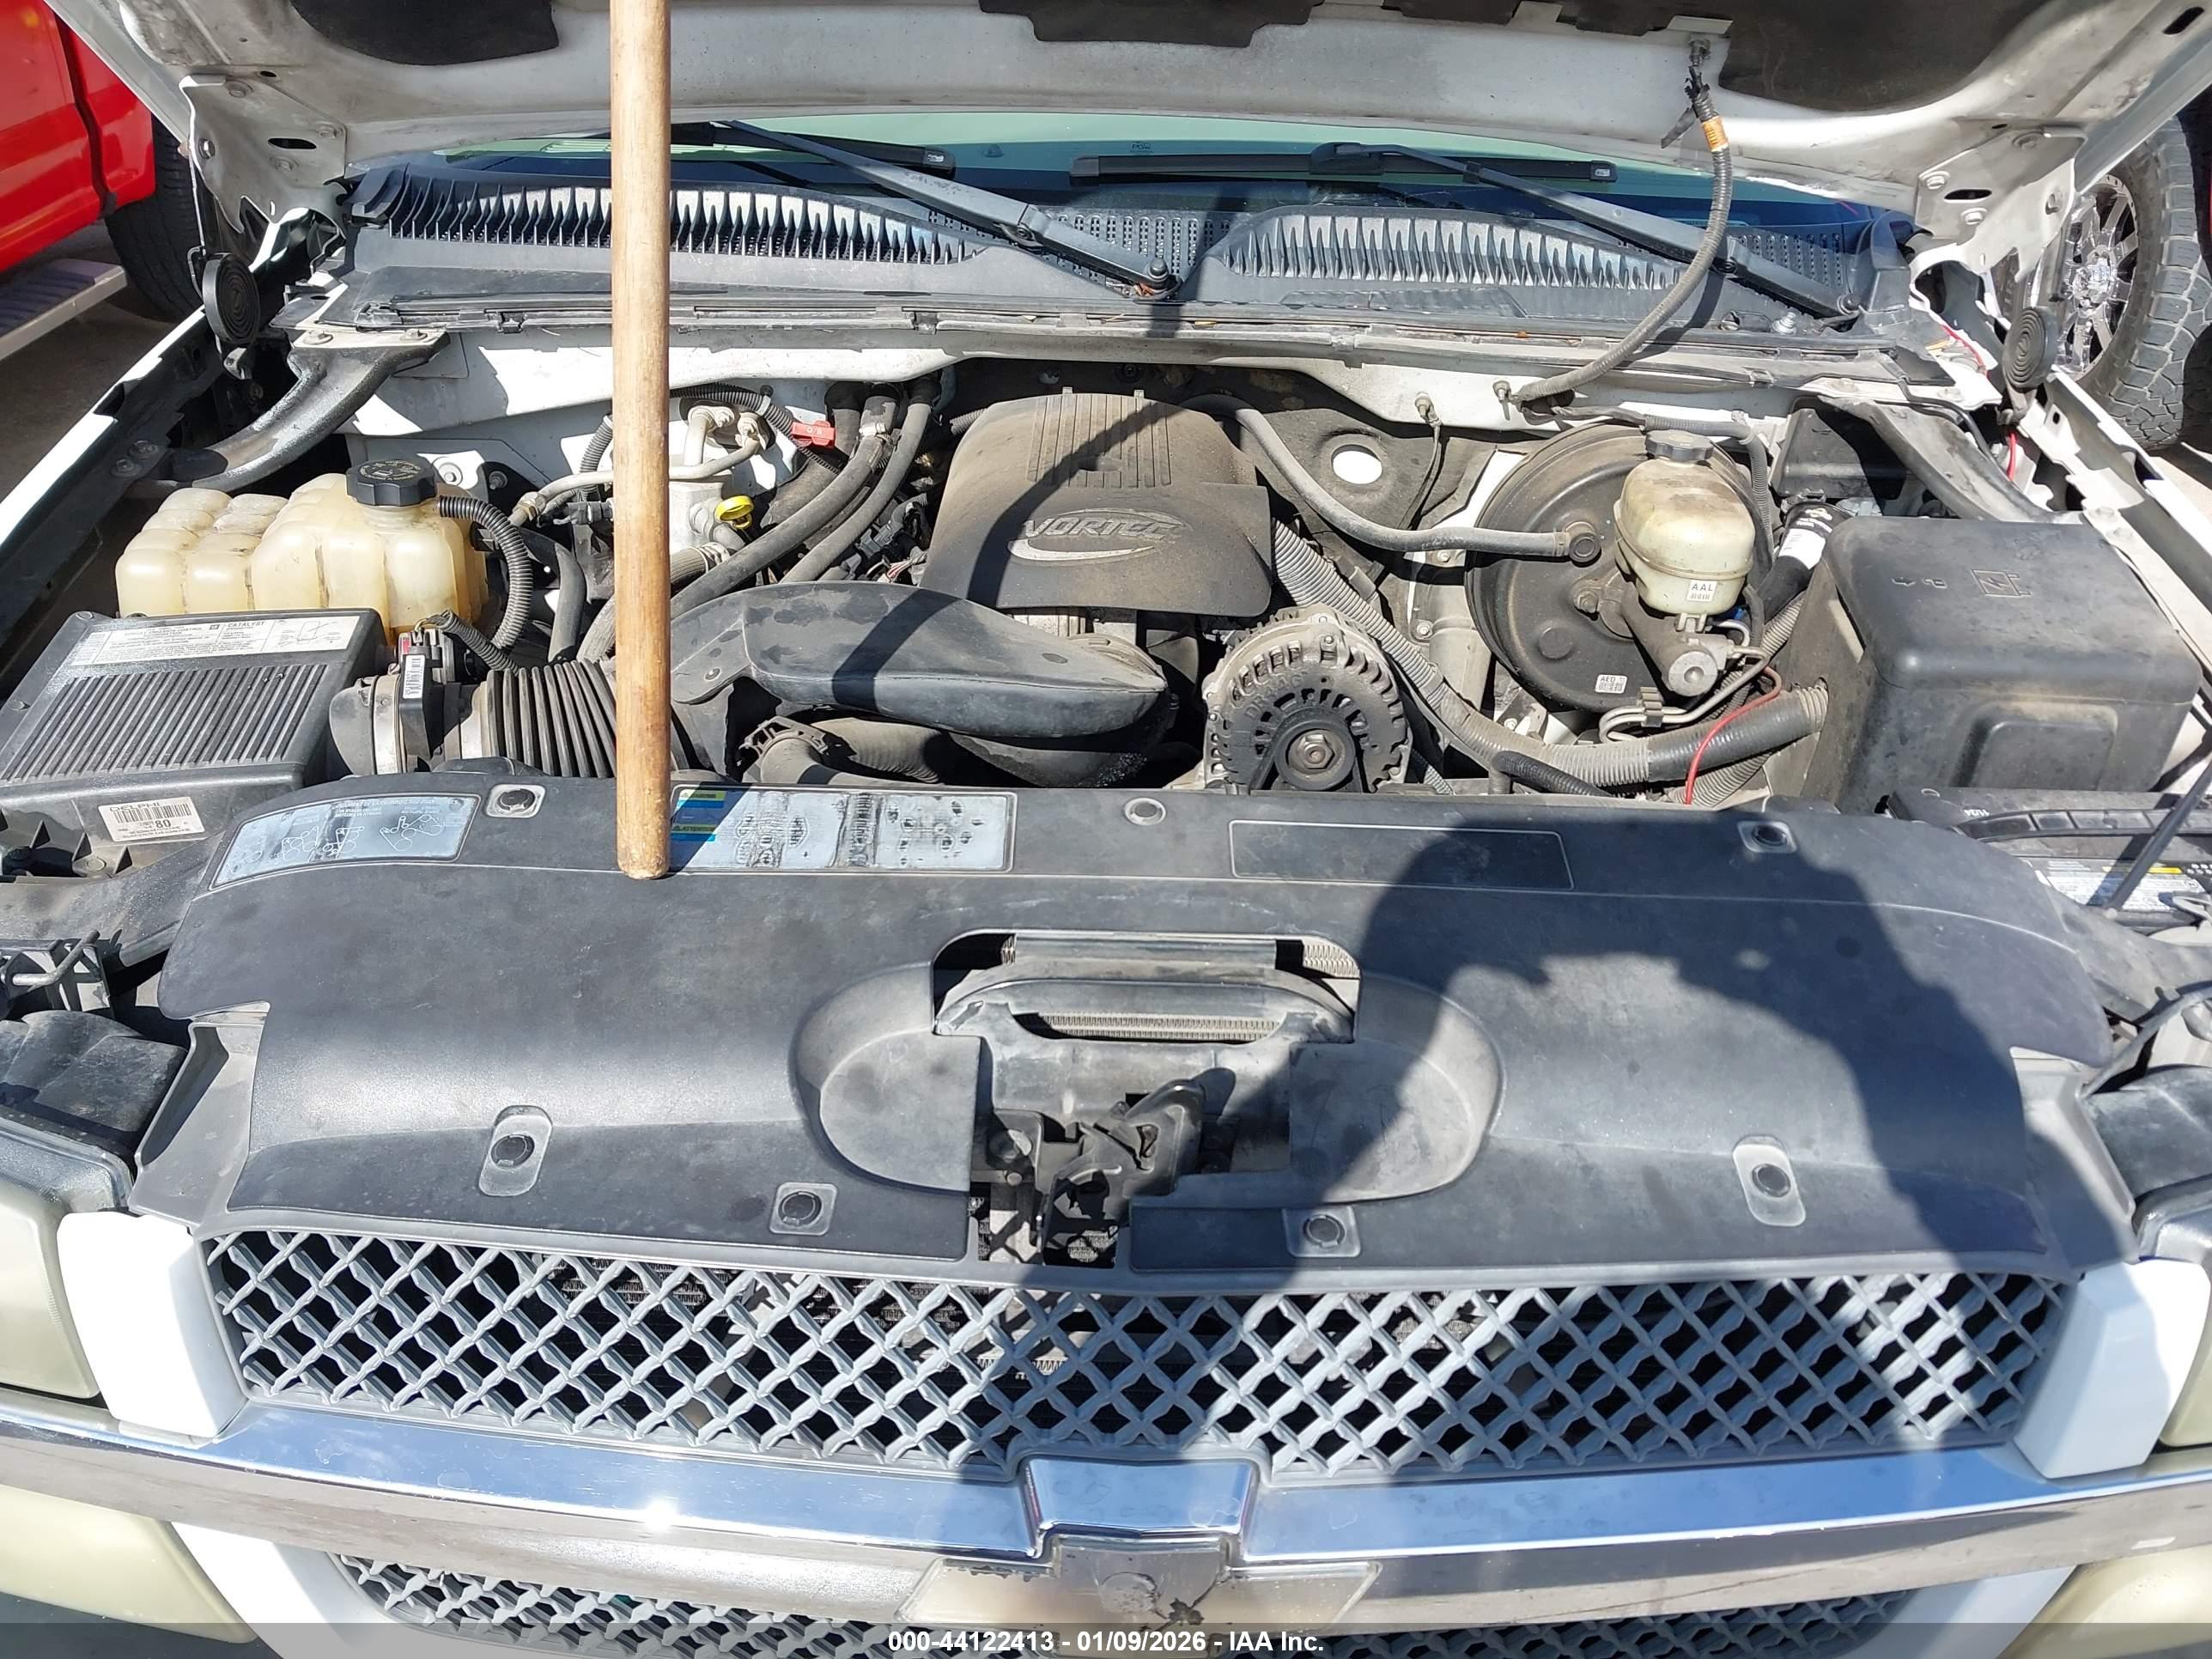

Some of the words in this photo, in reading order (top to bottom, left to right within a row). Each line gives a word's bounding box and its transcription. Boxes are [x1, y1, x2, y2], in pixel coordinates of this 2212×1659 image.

[1024, 516, 1177, 541] VORTEC
[1691, 582, 1714, 592] AAL
[110, 802, 161, 812] DELPHI
[155, 819, 172, 829] 80
